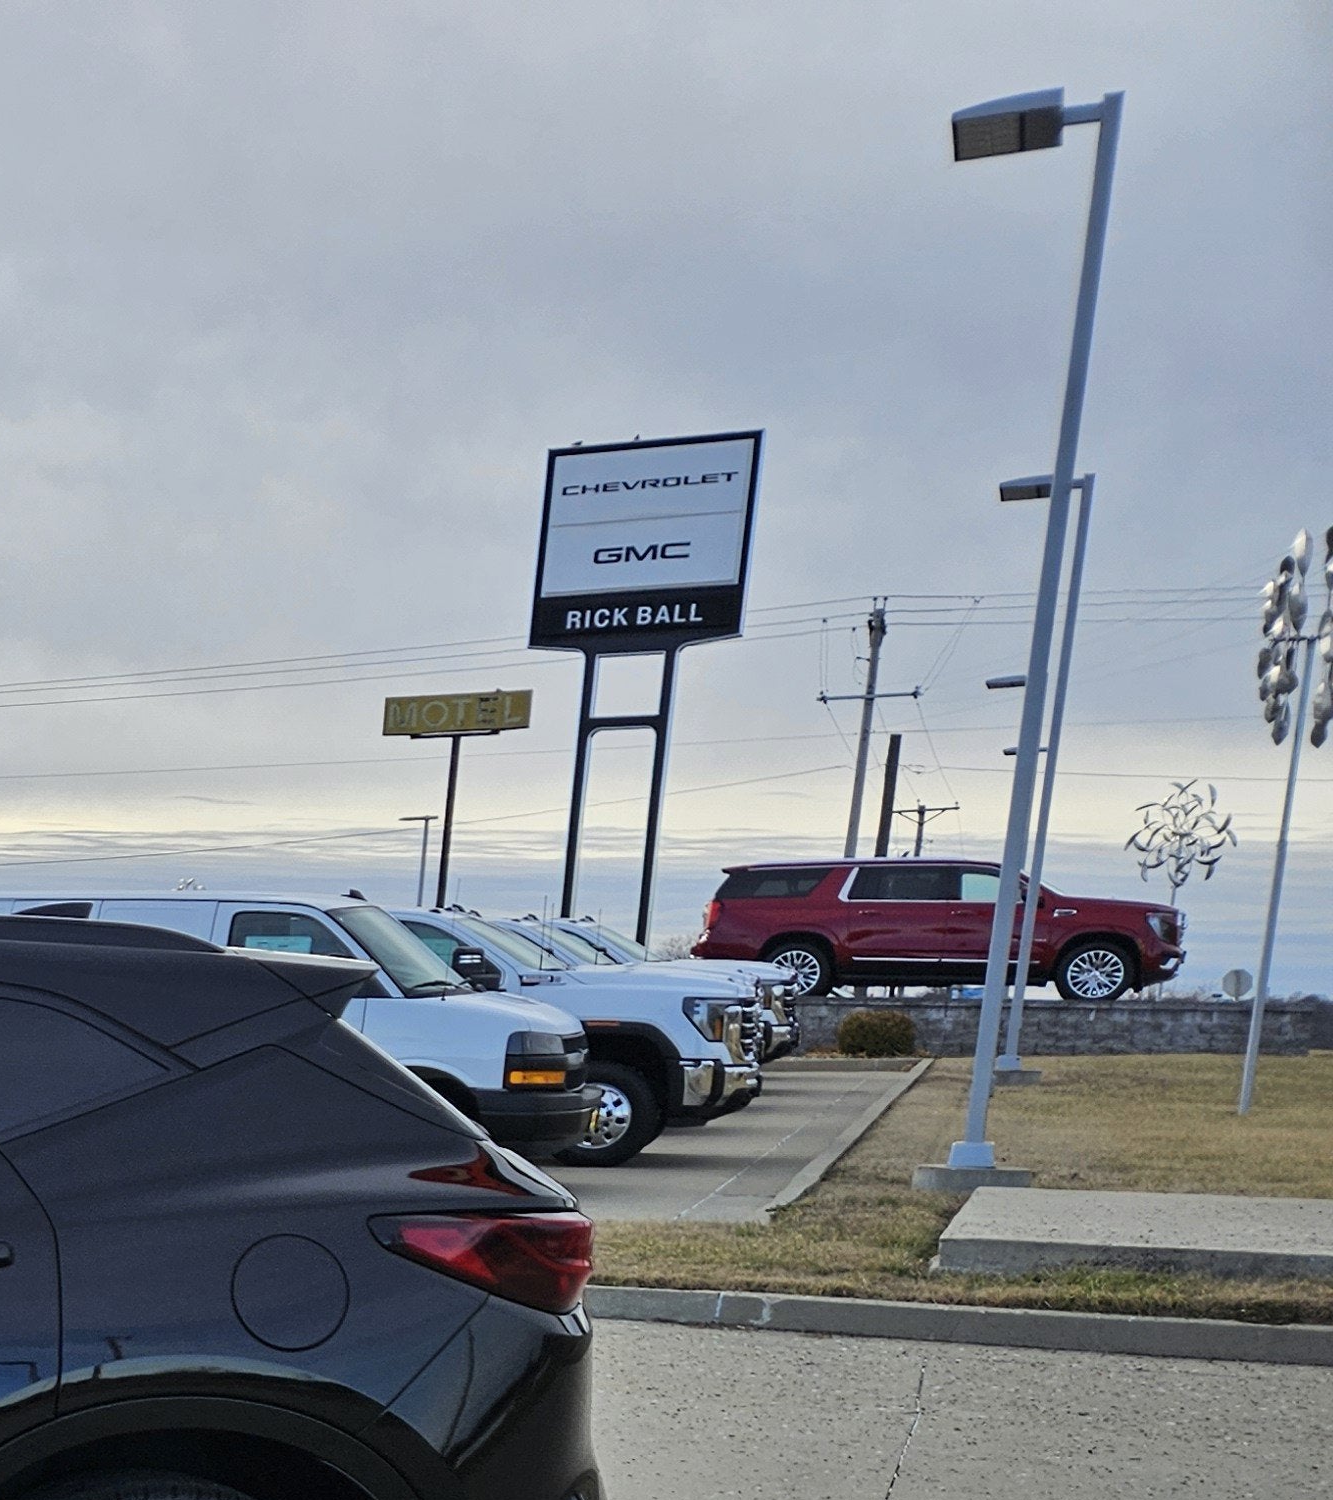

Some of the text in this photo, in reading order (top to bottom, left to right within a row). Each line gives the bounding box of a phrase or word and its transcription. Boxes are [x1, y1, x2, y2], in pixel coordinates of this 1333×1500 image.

[561, 471, 739, 496] CHEVROLET
[593, 541, 692, 565] GMC
[565, 603, 704, 630] RICK BALL
[388, 695, 523, 729] MOTEL
